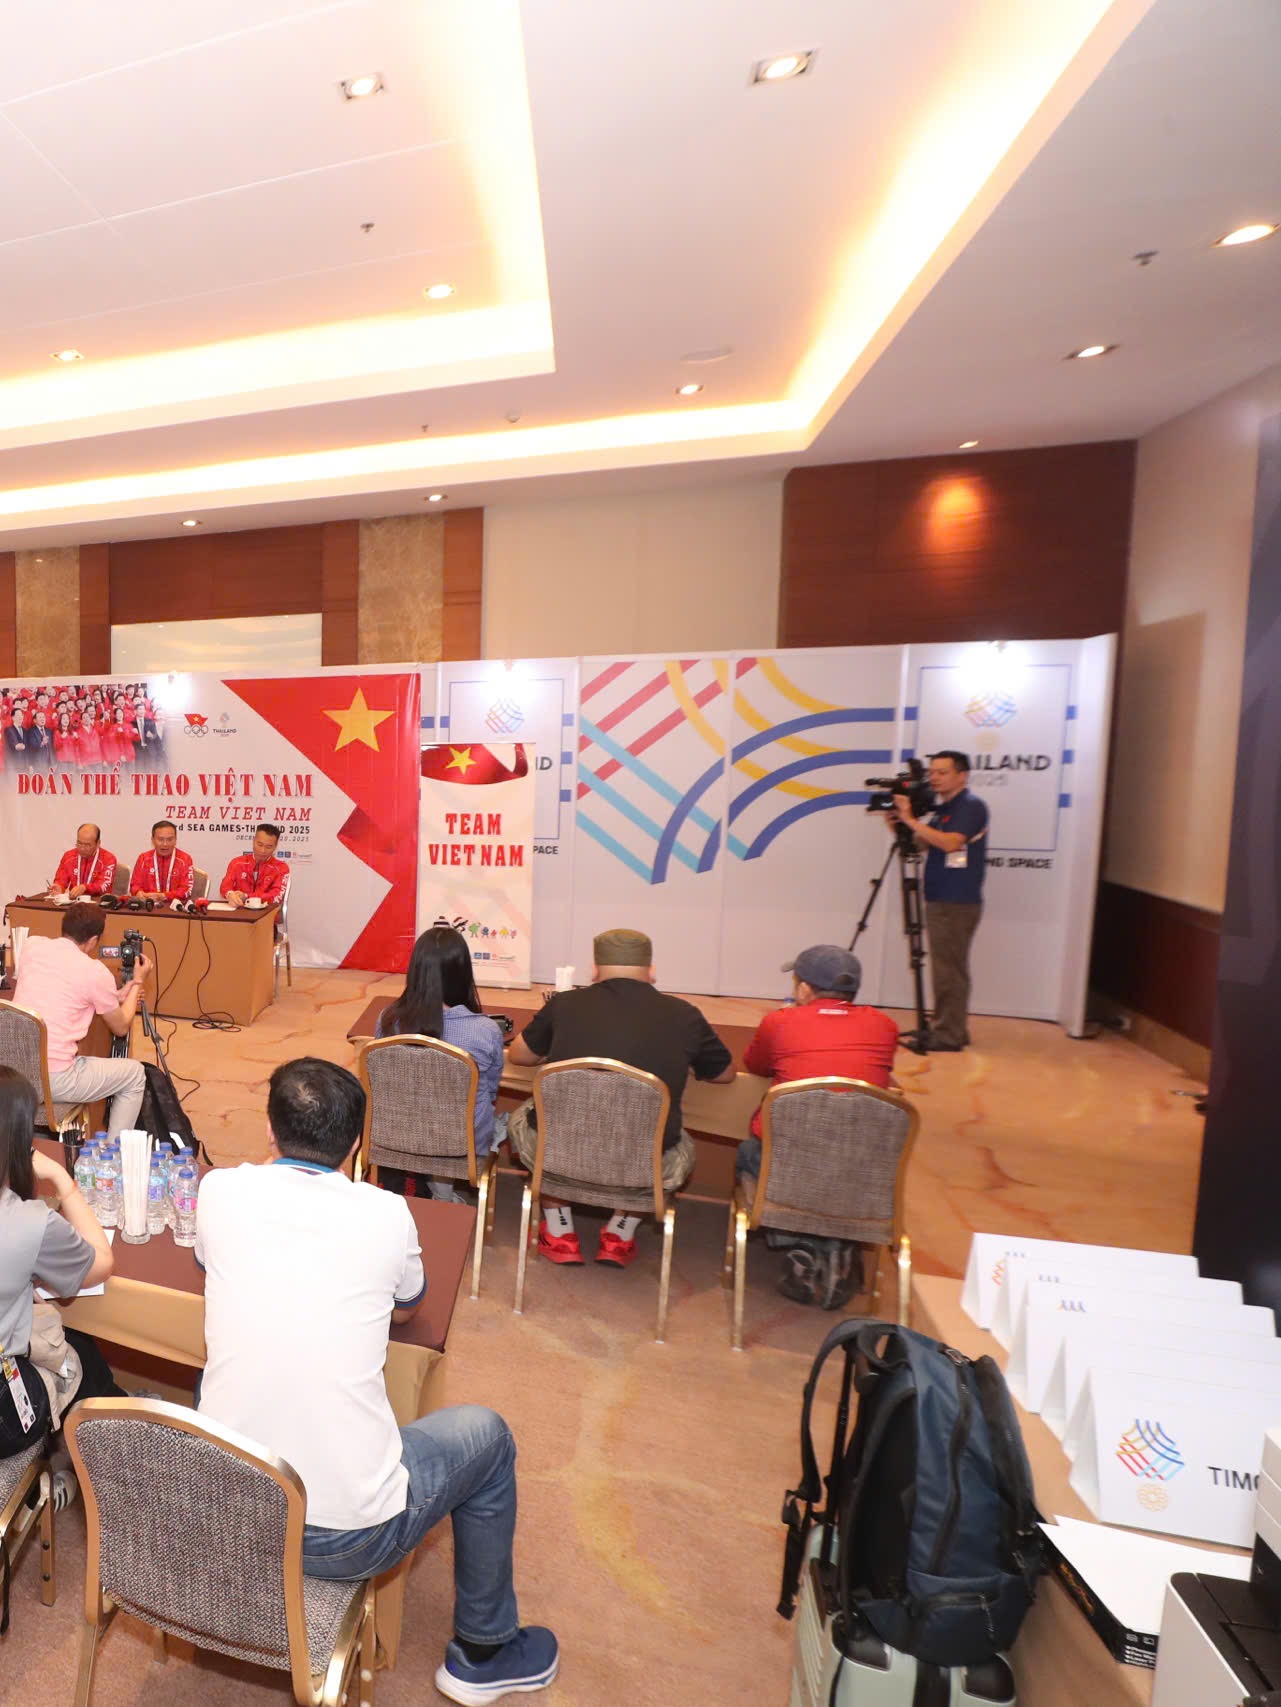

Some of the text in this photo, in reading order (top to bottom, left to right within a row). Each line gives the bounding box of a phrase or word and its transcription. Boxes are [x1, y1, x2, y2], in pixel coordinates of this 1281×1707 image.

[17, 761, 313, 802] ĐOÀN THỂ THAO VIỆT NAM
[166, 805, 312, 821] TEAM VIET NAM
[187, 824, 205, 832] SEA
[289, 826, 310, 834] 2025
[445, 813, 501, 835] TEAM
[429, 844, 524, 867] VIET NAM
[533, 845, 559, 855] PACE
